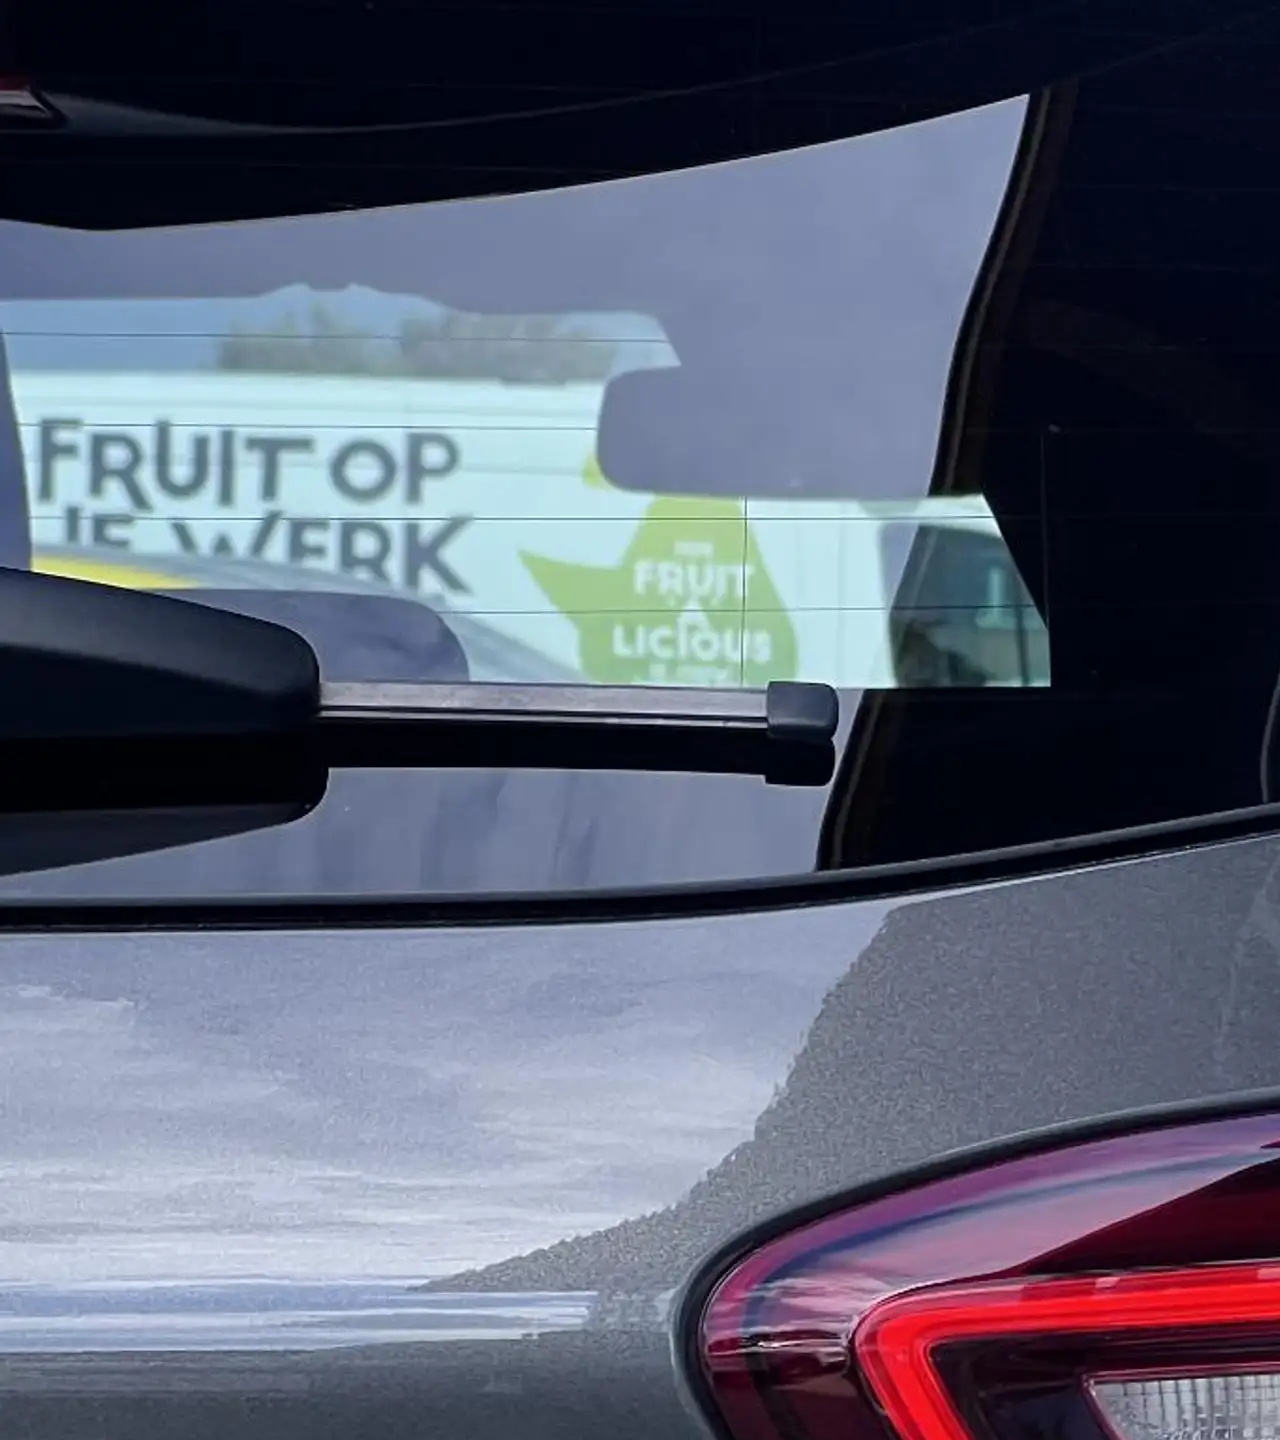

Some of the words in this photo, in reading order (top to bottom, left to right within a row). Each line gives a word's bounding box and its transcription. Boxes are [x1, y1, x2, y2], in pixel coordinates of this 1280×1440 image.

[38, 418, 316, 510] FRUIT
[329, 430, 460, 507] OP
[633, 558, 756, 600] FRUIT
[612, 618, 771, 664] LICIOUS
